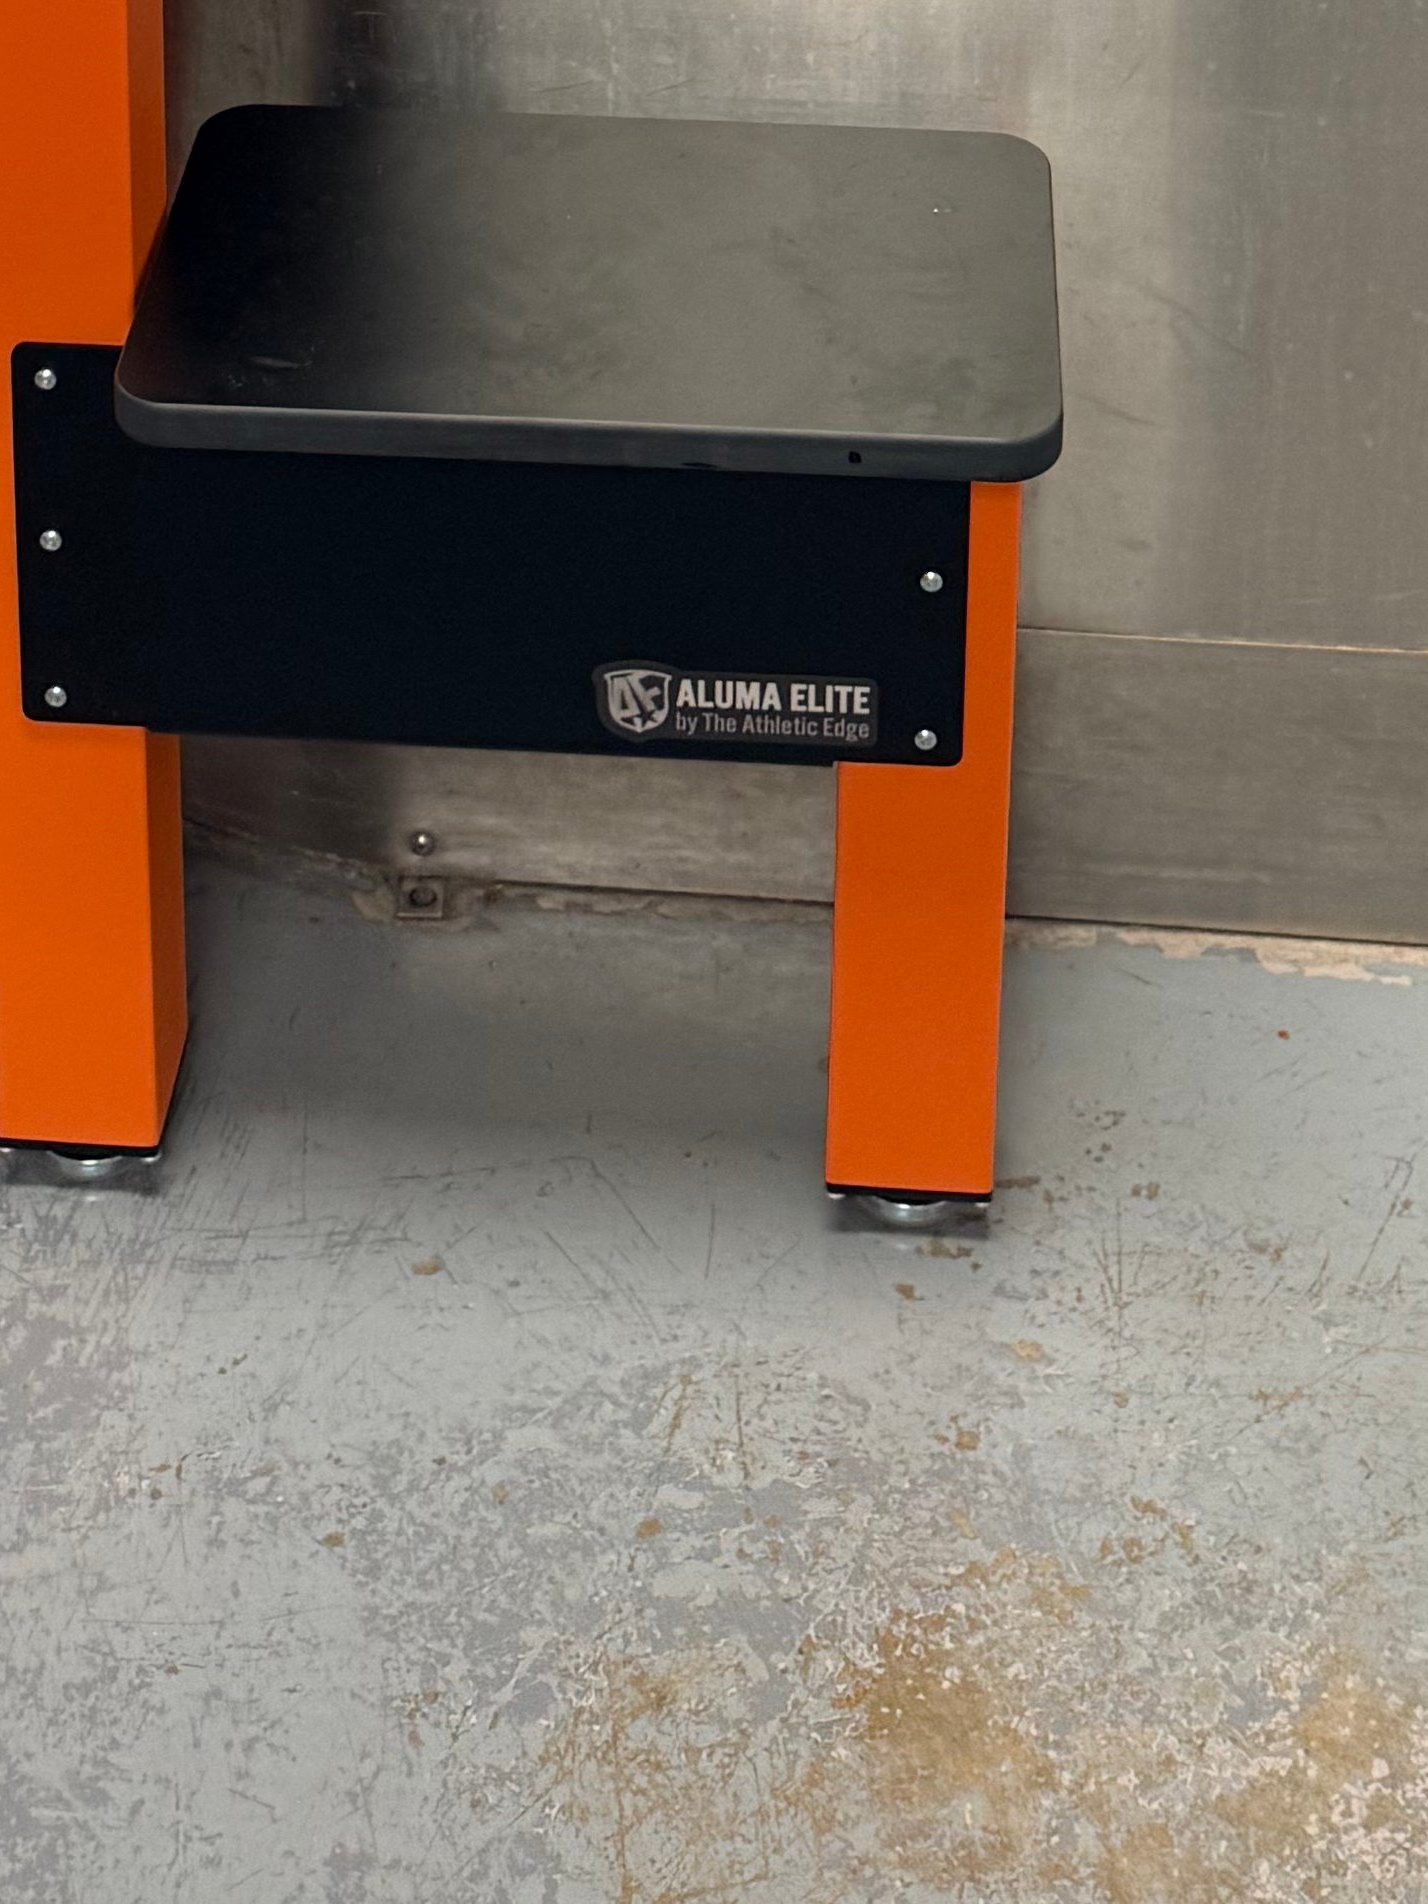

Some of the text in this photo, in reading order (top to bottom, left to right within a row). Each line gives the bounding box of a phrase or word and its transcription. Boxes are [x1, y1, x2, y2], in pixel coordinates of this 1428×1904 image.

[676, 678, 871, 715] ALUMA ELITE
[676, 712, 870, 741] by The Athletic Edge
